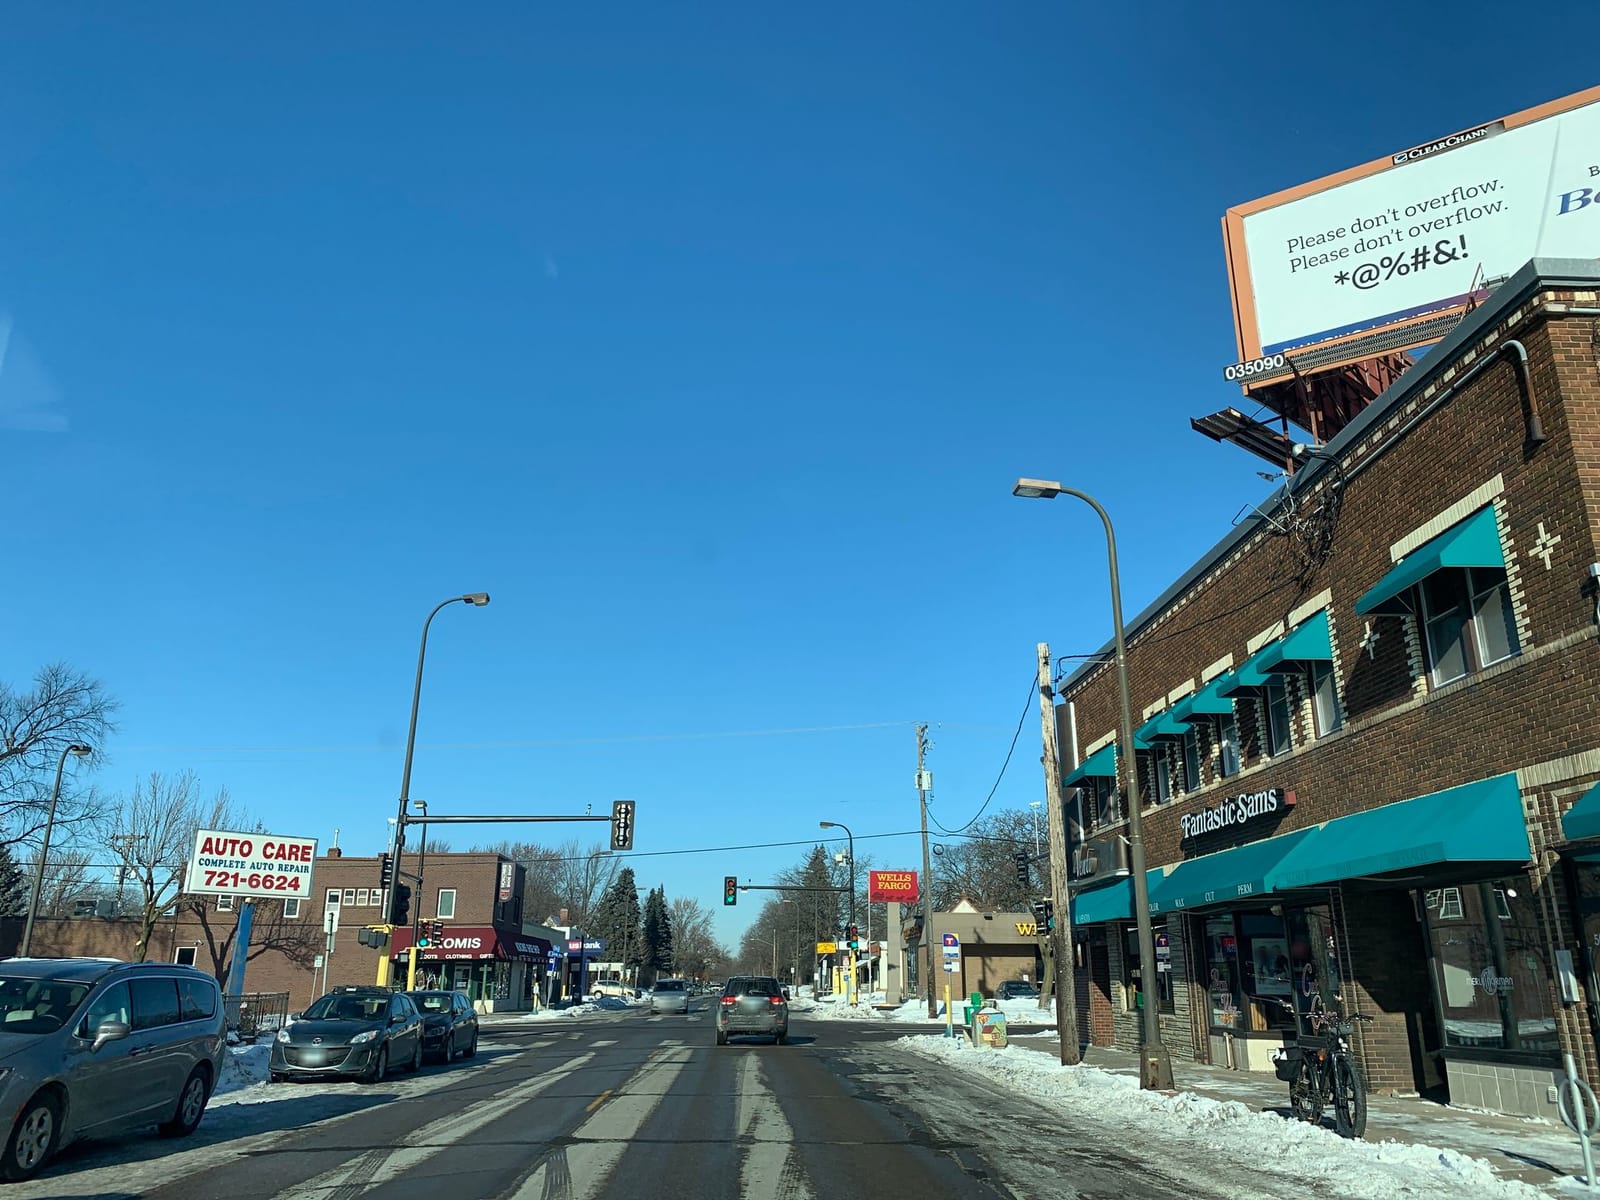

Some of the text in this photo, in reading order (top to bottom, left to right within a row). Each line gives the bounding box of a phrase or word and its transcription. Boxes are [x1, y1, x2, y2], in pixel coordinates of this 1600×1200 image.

[1286, 179, 1505, 264] Please don't overflow.
[1289, 200, 1509, 274] Please don't overflow.
[1225, 354, 1284, 380] 035090
[1180, 788, 1278, 839] Fantastic Sams
[200, 836, 313, 862] AUTO CARE
[198, 857, 310, 874] COMPLETE AUTO REPAIR
[204, 869, 301, 892] 721-6624
[876, 873, 912, 882] WELLS
[877, 882, 912, 890] FARGO
[1204, 891, 1216, 902] CUT
[1237, 883, 1253, 896] PERM
